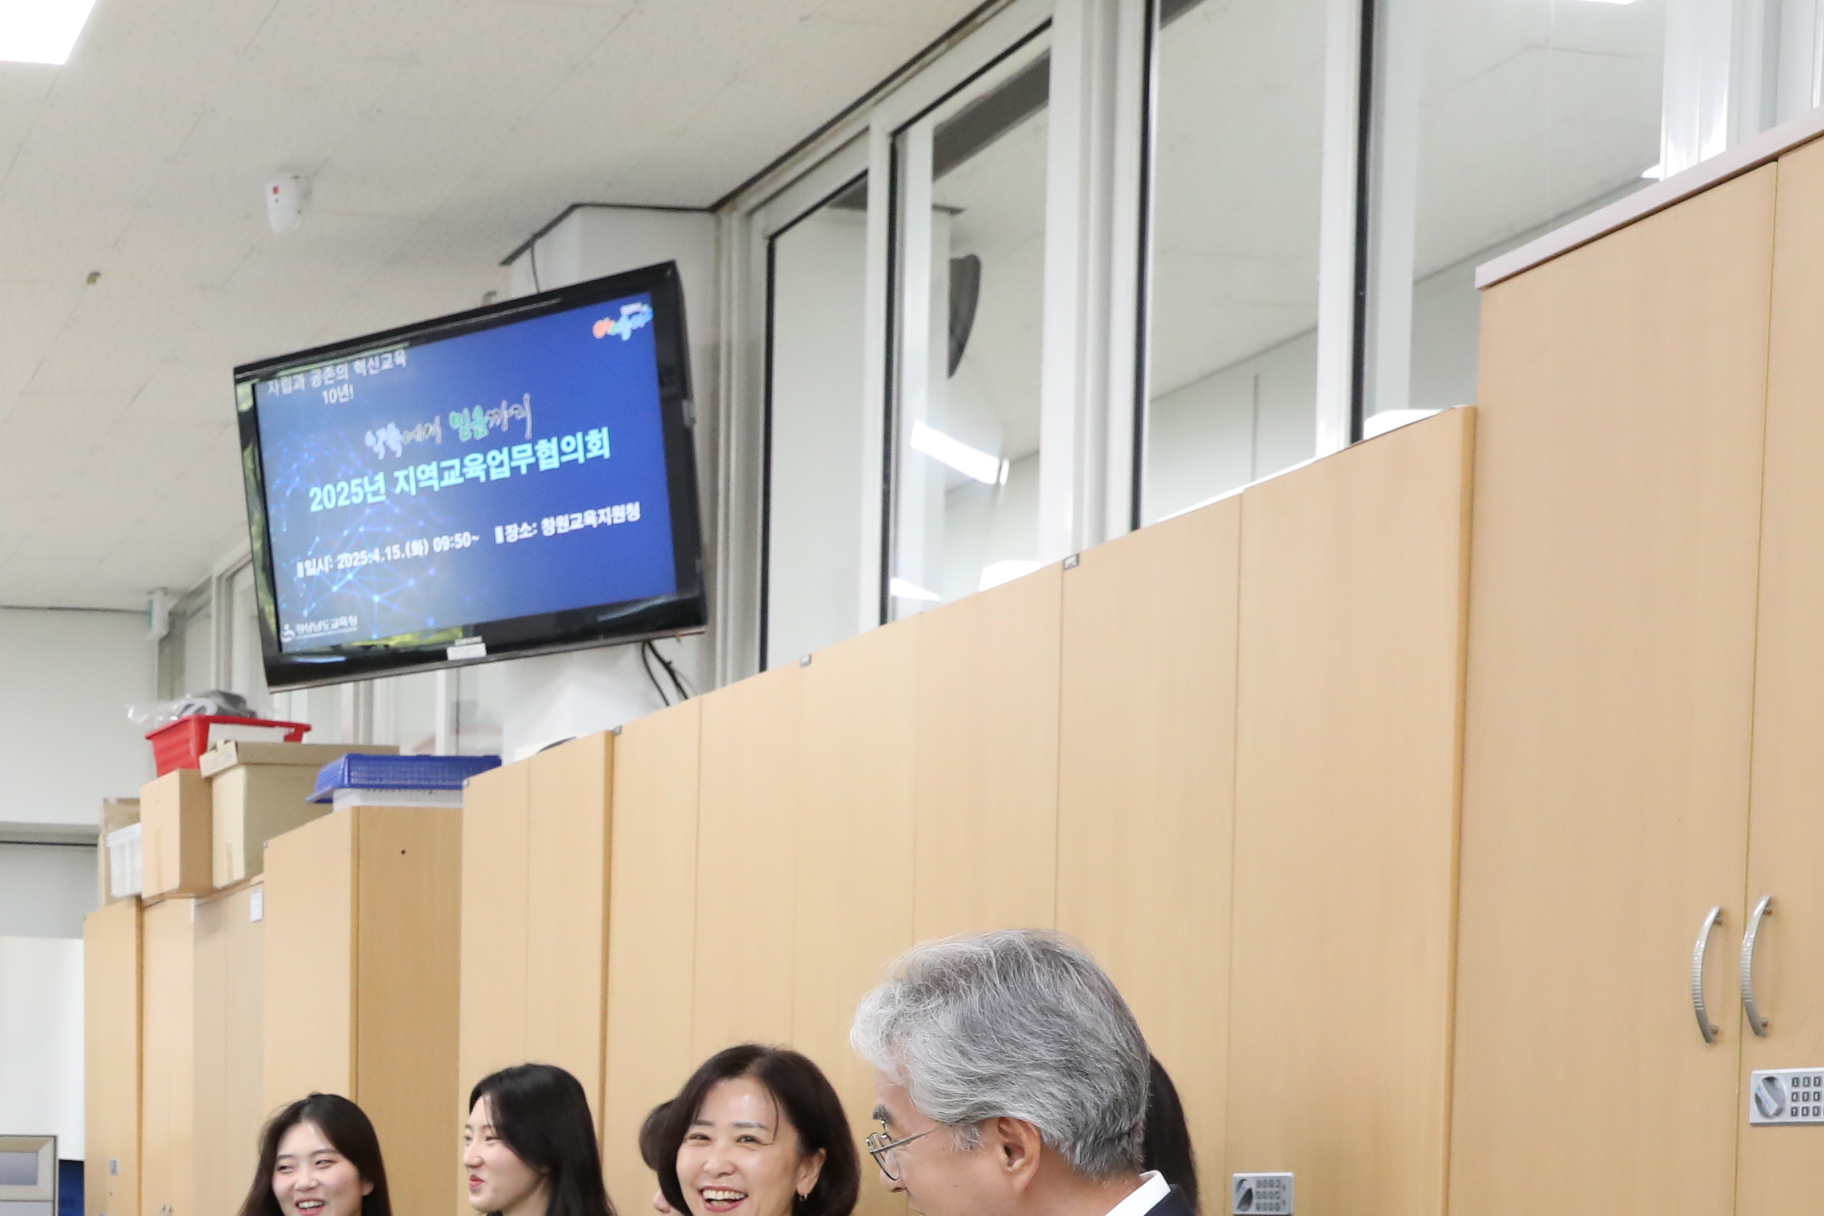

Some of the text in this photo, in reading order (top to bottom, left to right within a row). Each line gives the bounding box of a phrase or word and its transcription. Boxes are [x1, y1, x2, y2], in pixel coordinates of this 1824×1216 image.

[322, 383, 354, 405] 10년!
[308, 427, 611, 512] 2025년 지역교육업무협의회
[504, 501, 641, 543] 장소: 창원교육지원청
[433, 531, 480, 553] 09:50~
